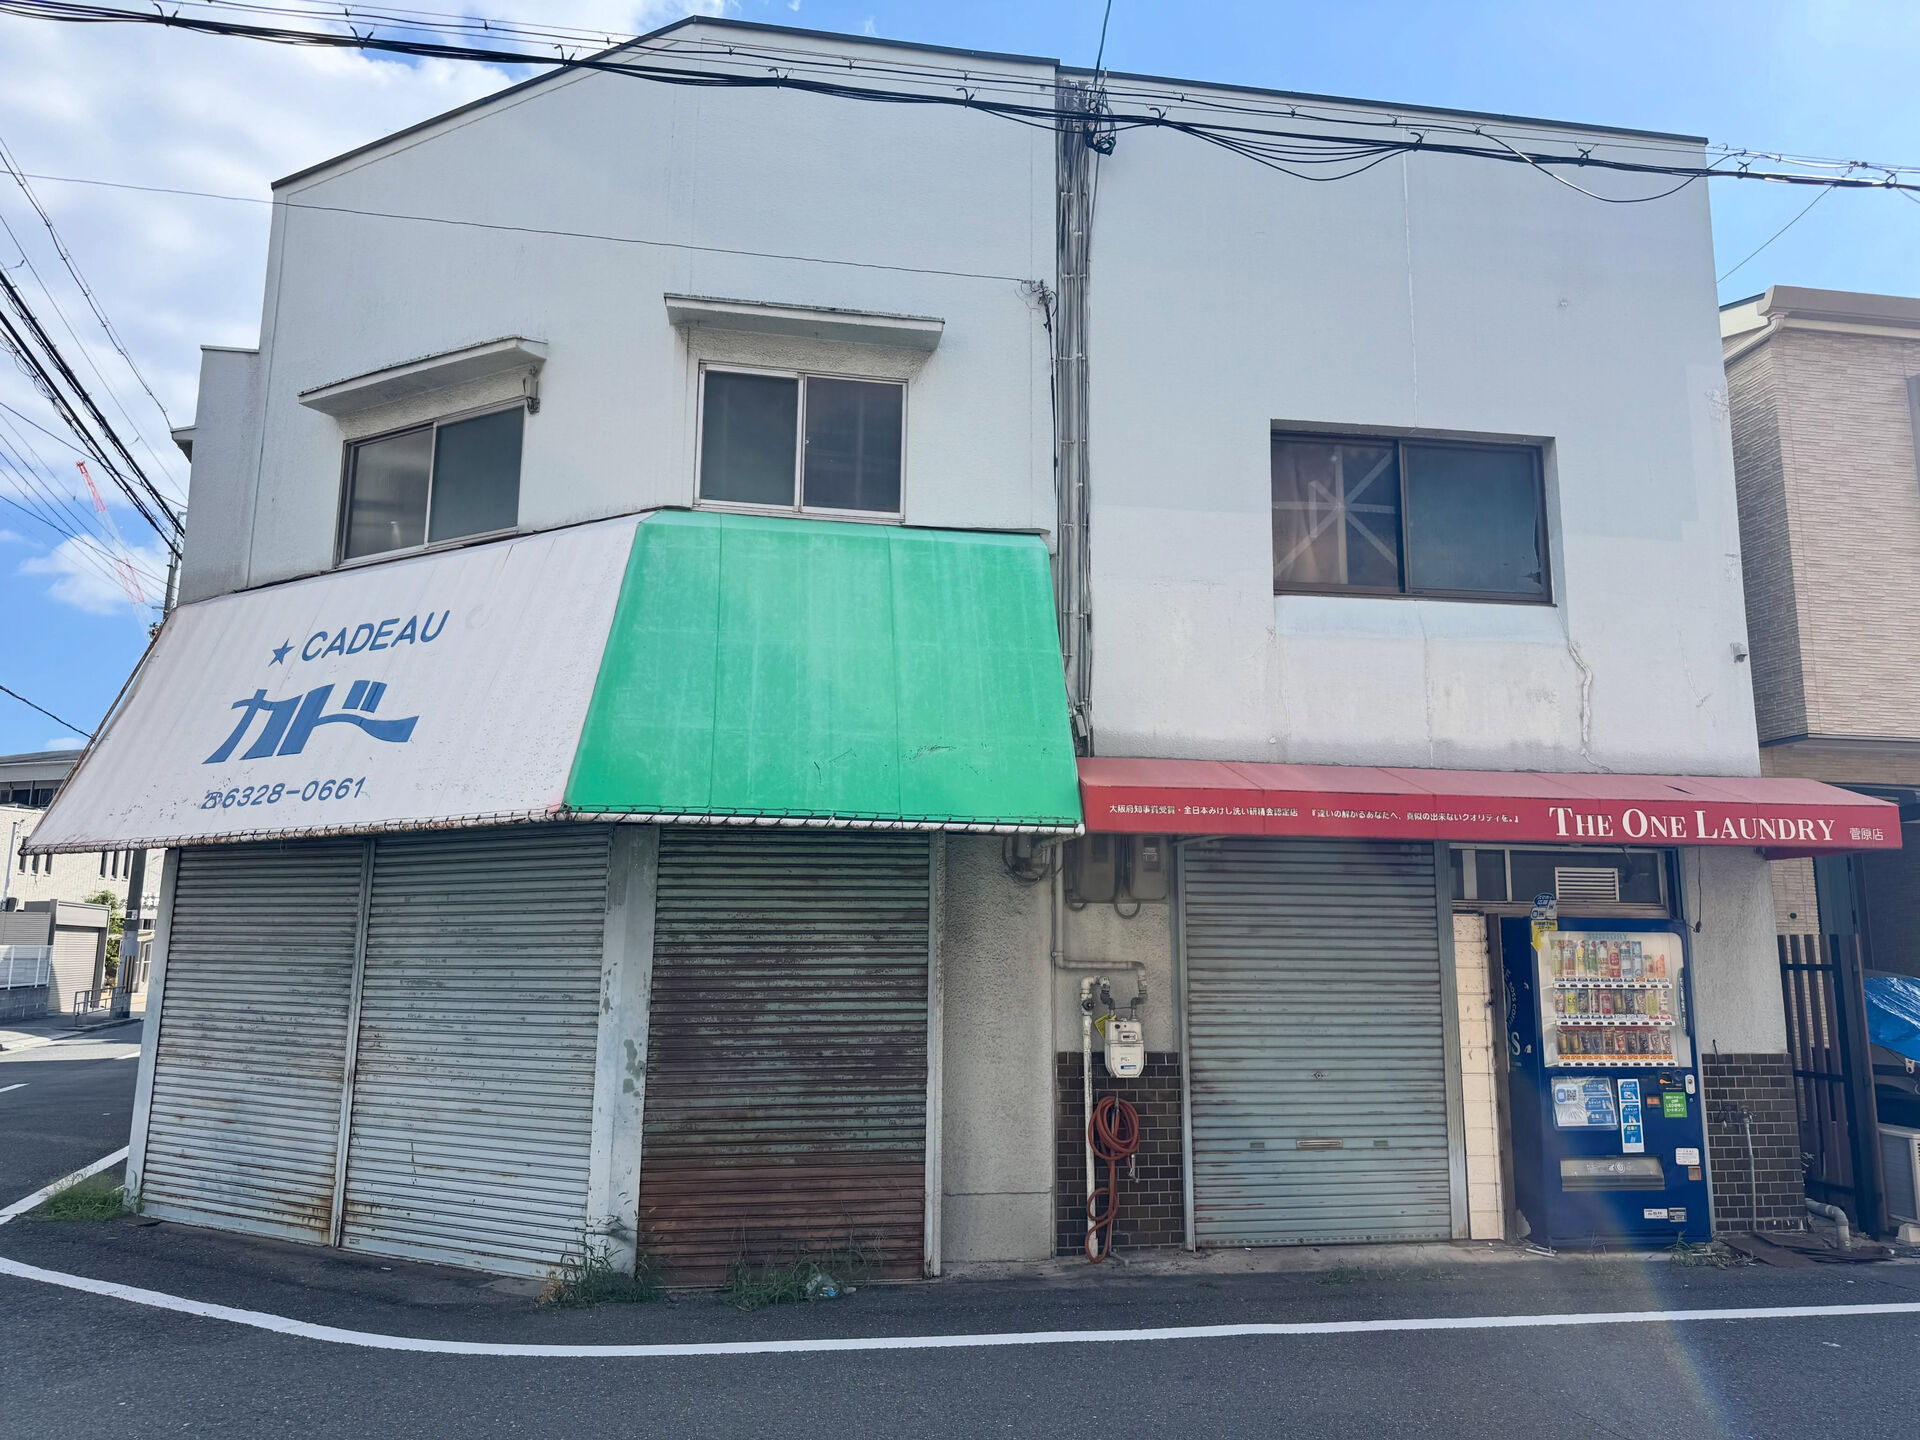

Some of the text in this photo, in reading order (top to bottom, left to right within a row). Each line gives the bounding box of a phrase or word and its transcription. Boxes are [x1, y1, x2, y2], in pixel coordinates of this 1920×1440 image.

[302, 610, 450, 661] CADEAU
[1549, 807, 1836, 841] THE ONE LAUNDRY
[1849, 827, 1884, 841] 菅原店
